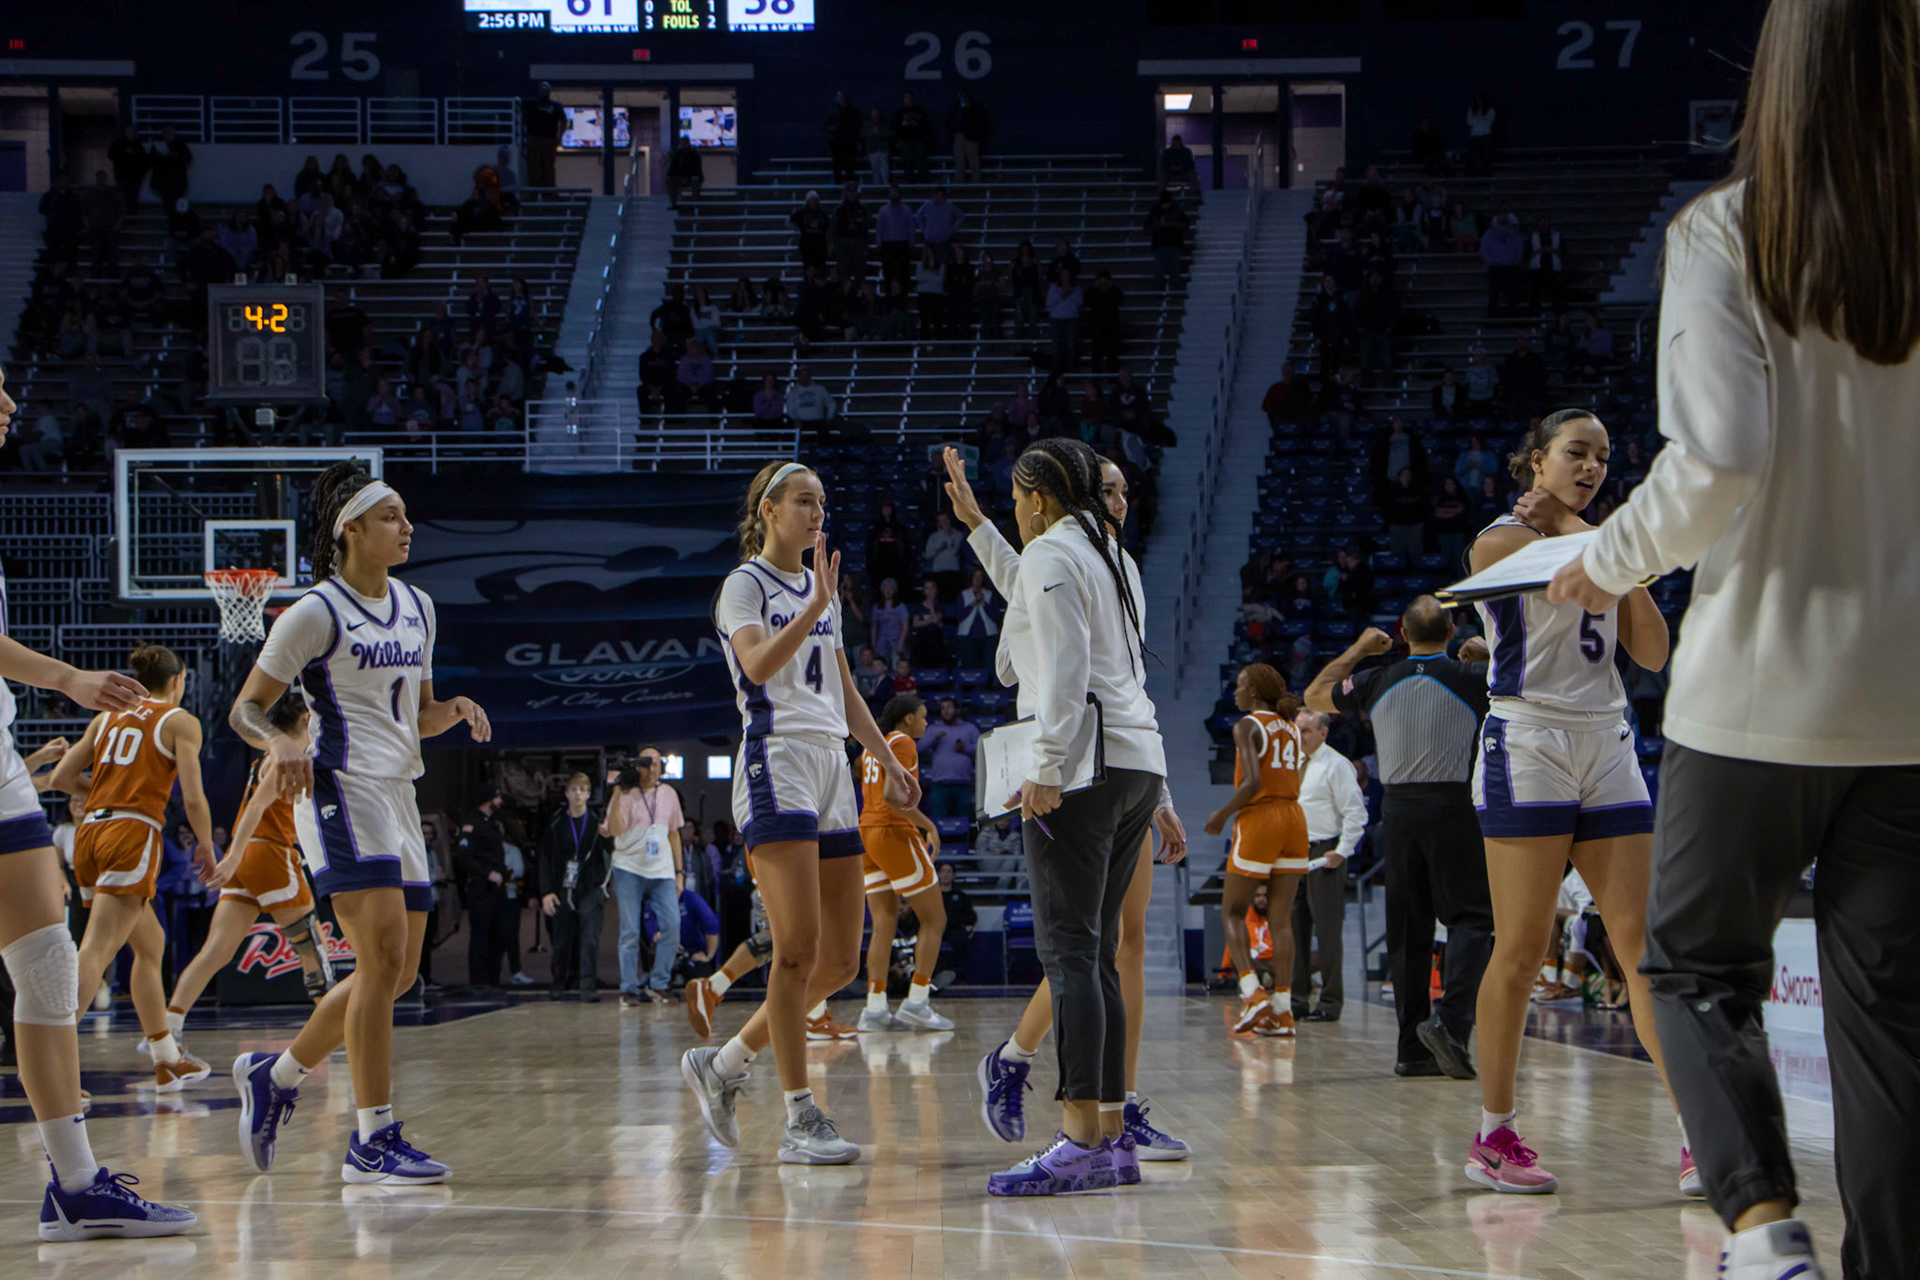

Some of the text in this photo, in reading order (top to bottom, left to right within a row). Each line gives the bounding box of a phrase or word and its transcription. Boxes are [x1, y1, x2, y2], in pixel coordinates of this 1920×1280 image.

[479, 13, 545, 29] 2:56 PM
[645, 15, 654, 30] 3
[663, 15, 700, 30] FOULS
[707, 15, 716, 30] 2
[671, 0, 693, 13] TOL
[707, 0, 715, 13] 1
[289, 30, 381, 81] 25
[903, 30, 993, 80] 26
[1556, 20, 1641, 70] 27
[244, 303, 288, 333] 4.2
[1579, 608, 1606, 664] 5
[805, 645, 823, 694] 4
[391, 676, 405, 723] 1
[101, 726, 143, 766] 10
[1271, 738, 1296, 770] 14
[864, 756, 880, 784] 35
